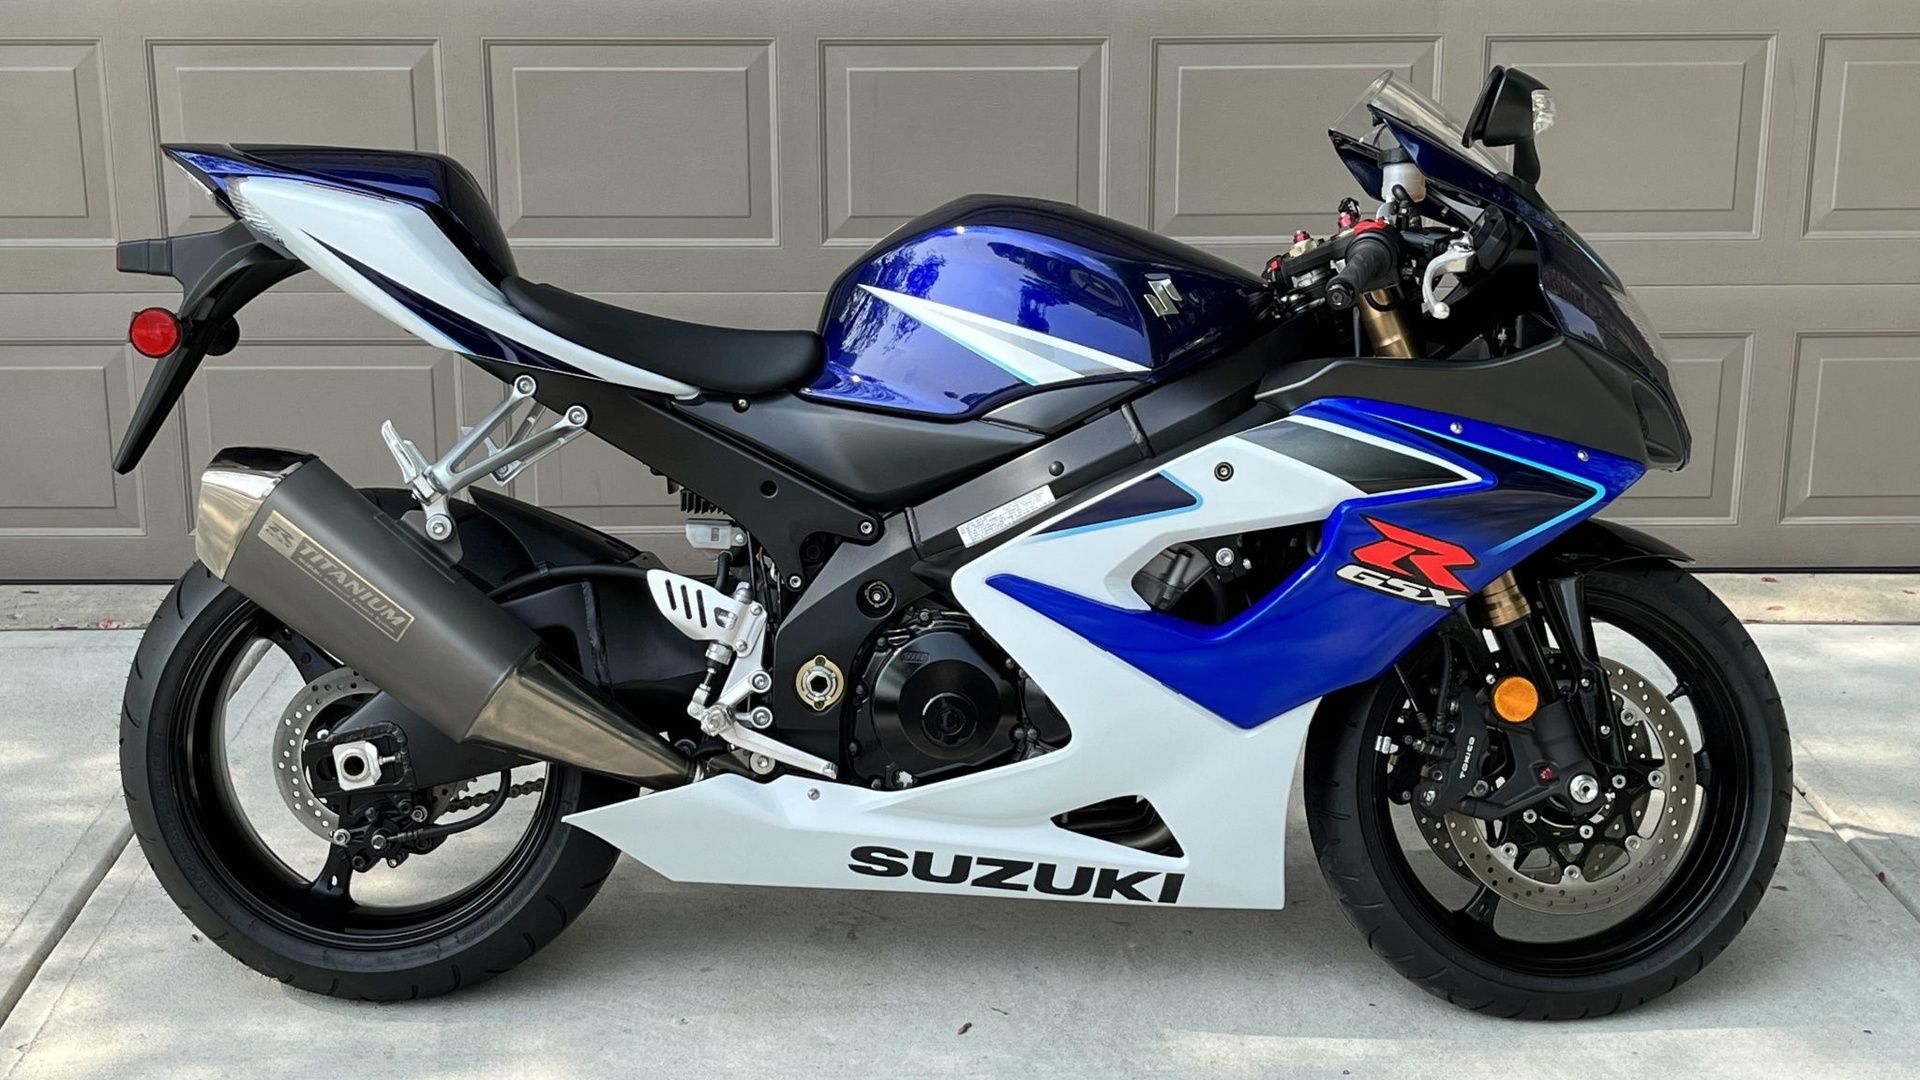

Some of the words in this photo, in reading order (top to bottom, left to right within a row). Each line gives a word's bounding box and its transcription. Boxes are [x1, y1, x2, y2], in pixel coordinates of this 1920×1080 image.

[299, 542, 406, 627] TITANIUM
[1353, 516, 1477, 593] R
[1459, 736, 1476, 779] TOKICO
[847, 845, 1186, 904] SUZUKI
